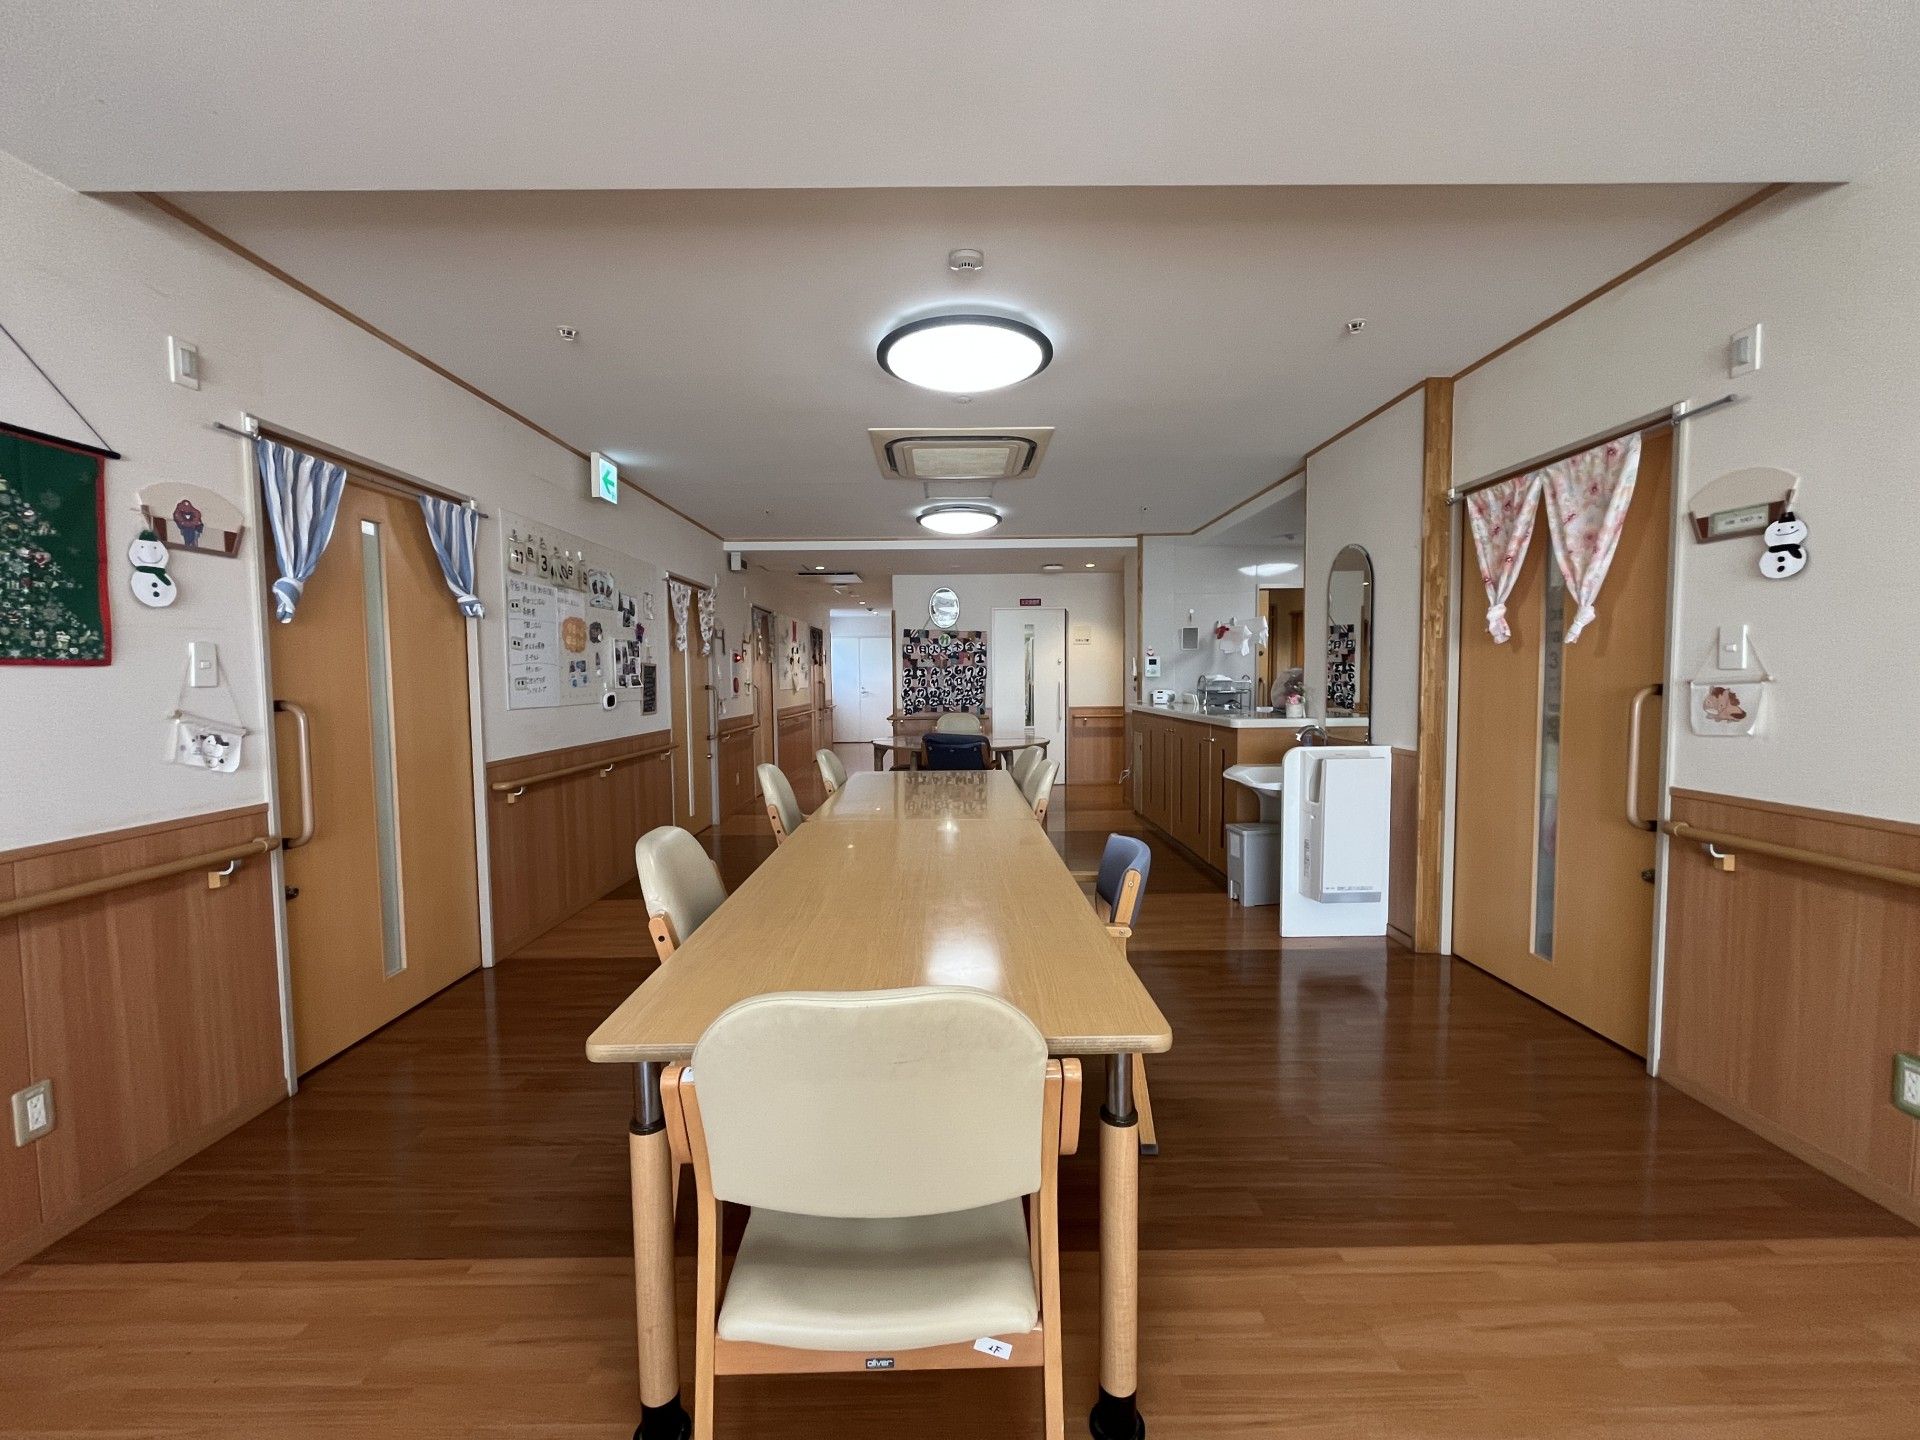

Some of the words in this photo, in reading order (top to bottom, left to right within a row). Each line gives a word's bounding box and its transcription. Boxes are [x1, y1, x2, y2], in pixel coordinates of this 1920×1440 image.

[905, 644, 913, 654] 日
[919, 645, 927, 654] 月
[929, 645, 939, 654] 火
[953, 642, 963, 651] 木
[966, 642, 975, 651] 金
[976, 642, 986, 651] 土
[976, 653, 985, 663] 1
[904, 668, 912, 677] 2
[918, 668, 926, 677] 3
[931, 667, 940, 676] 4
[944, 666, 952, 676] 5
[954, 665, 962, 675] 6
[967, 666, 974, 677] 7
[976, 667, 984, 677] 8
[904, 678, 912, 687] 9
[917, 677, 926, 686] 10
[930, 678, 939, 687] 11
[955, 677, 963, 686] 13
[964, 677, 974, 687] 14
[975, 677, 984, 687] 15
[916, 688, 925, 697] 17
[942, 689, 951, 697] 19
[943, 698, 953, 706] 26
[963, 697, 974, 706] 28
